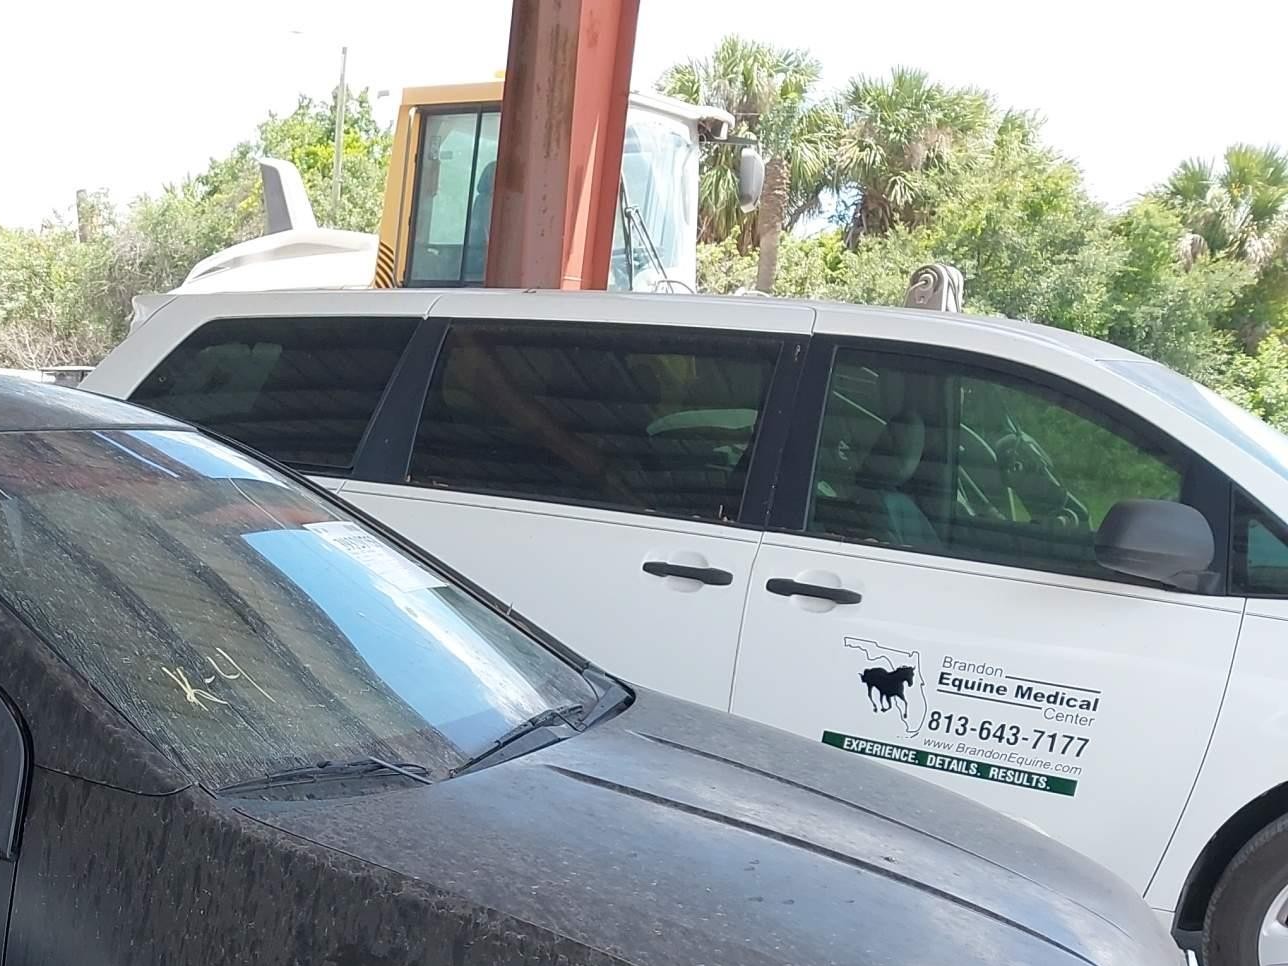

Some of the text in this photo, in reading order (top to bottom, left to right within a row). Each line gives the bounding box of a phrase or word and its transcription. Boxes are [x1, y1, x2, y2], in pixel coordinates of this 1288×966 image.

[161, 647, 277, 712] K-4
[942, 655, 1004, 678] Brandon
[937, 671, 1100, 712] Equine Medical
[927, 710, 1090, 758] 813-643-7177
[1043, 707, 1095, 727] Center
[843, 736, 1051, 791] EXPERIENCE. DETAILS. RESULTS.
